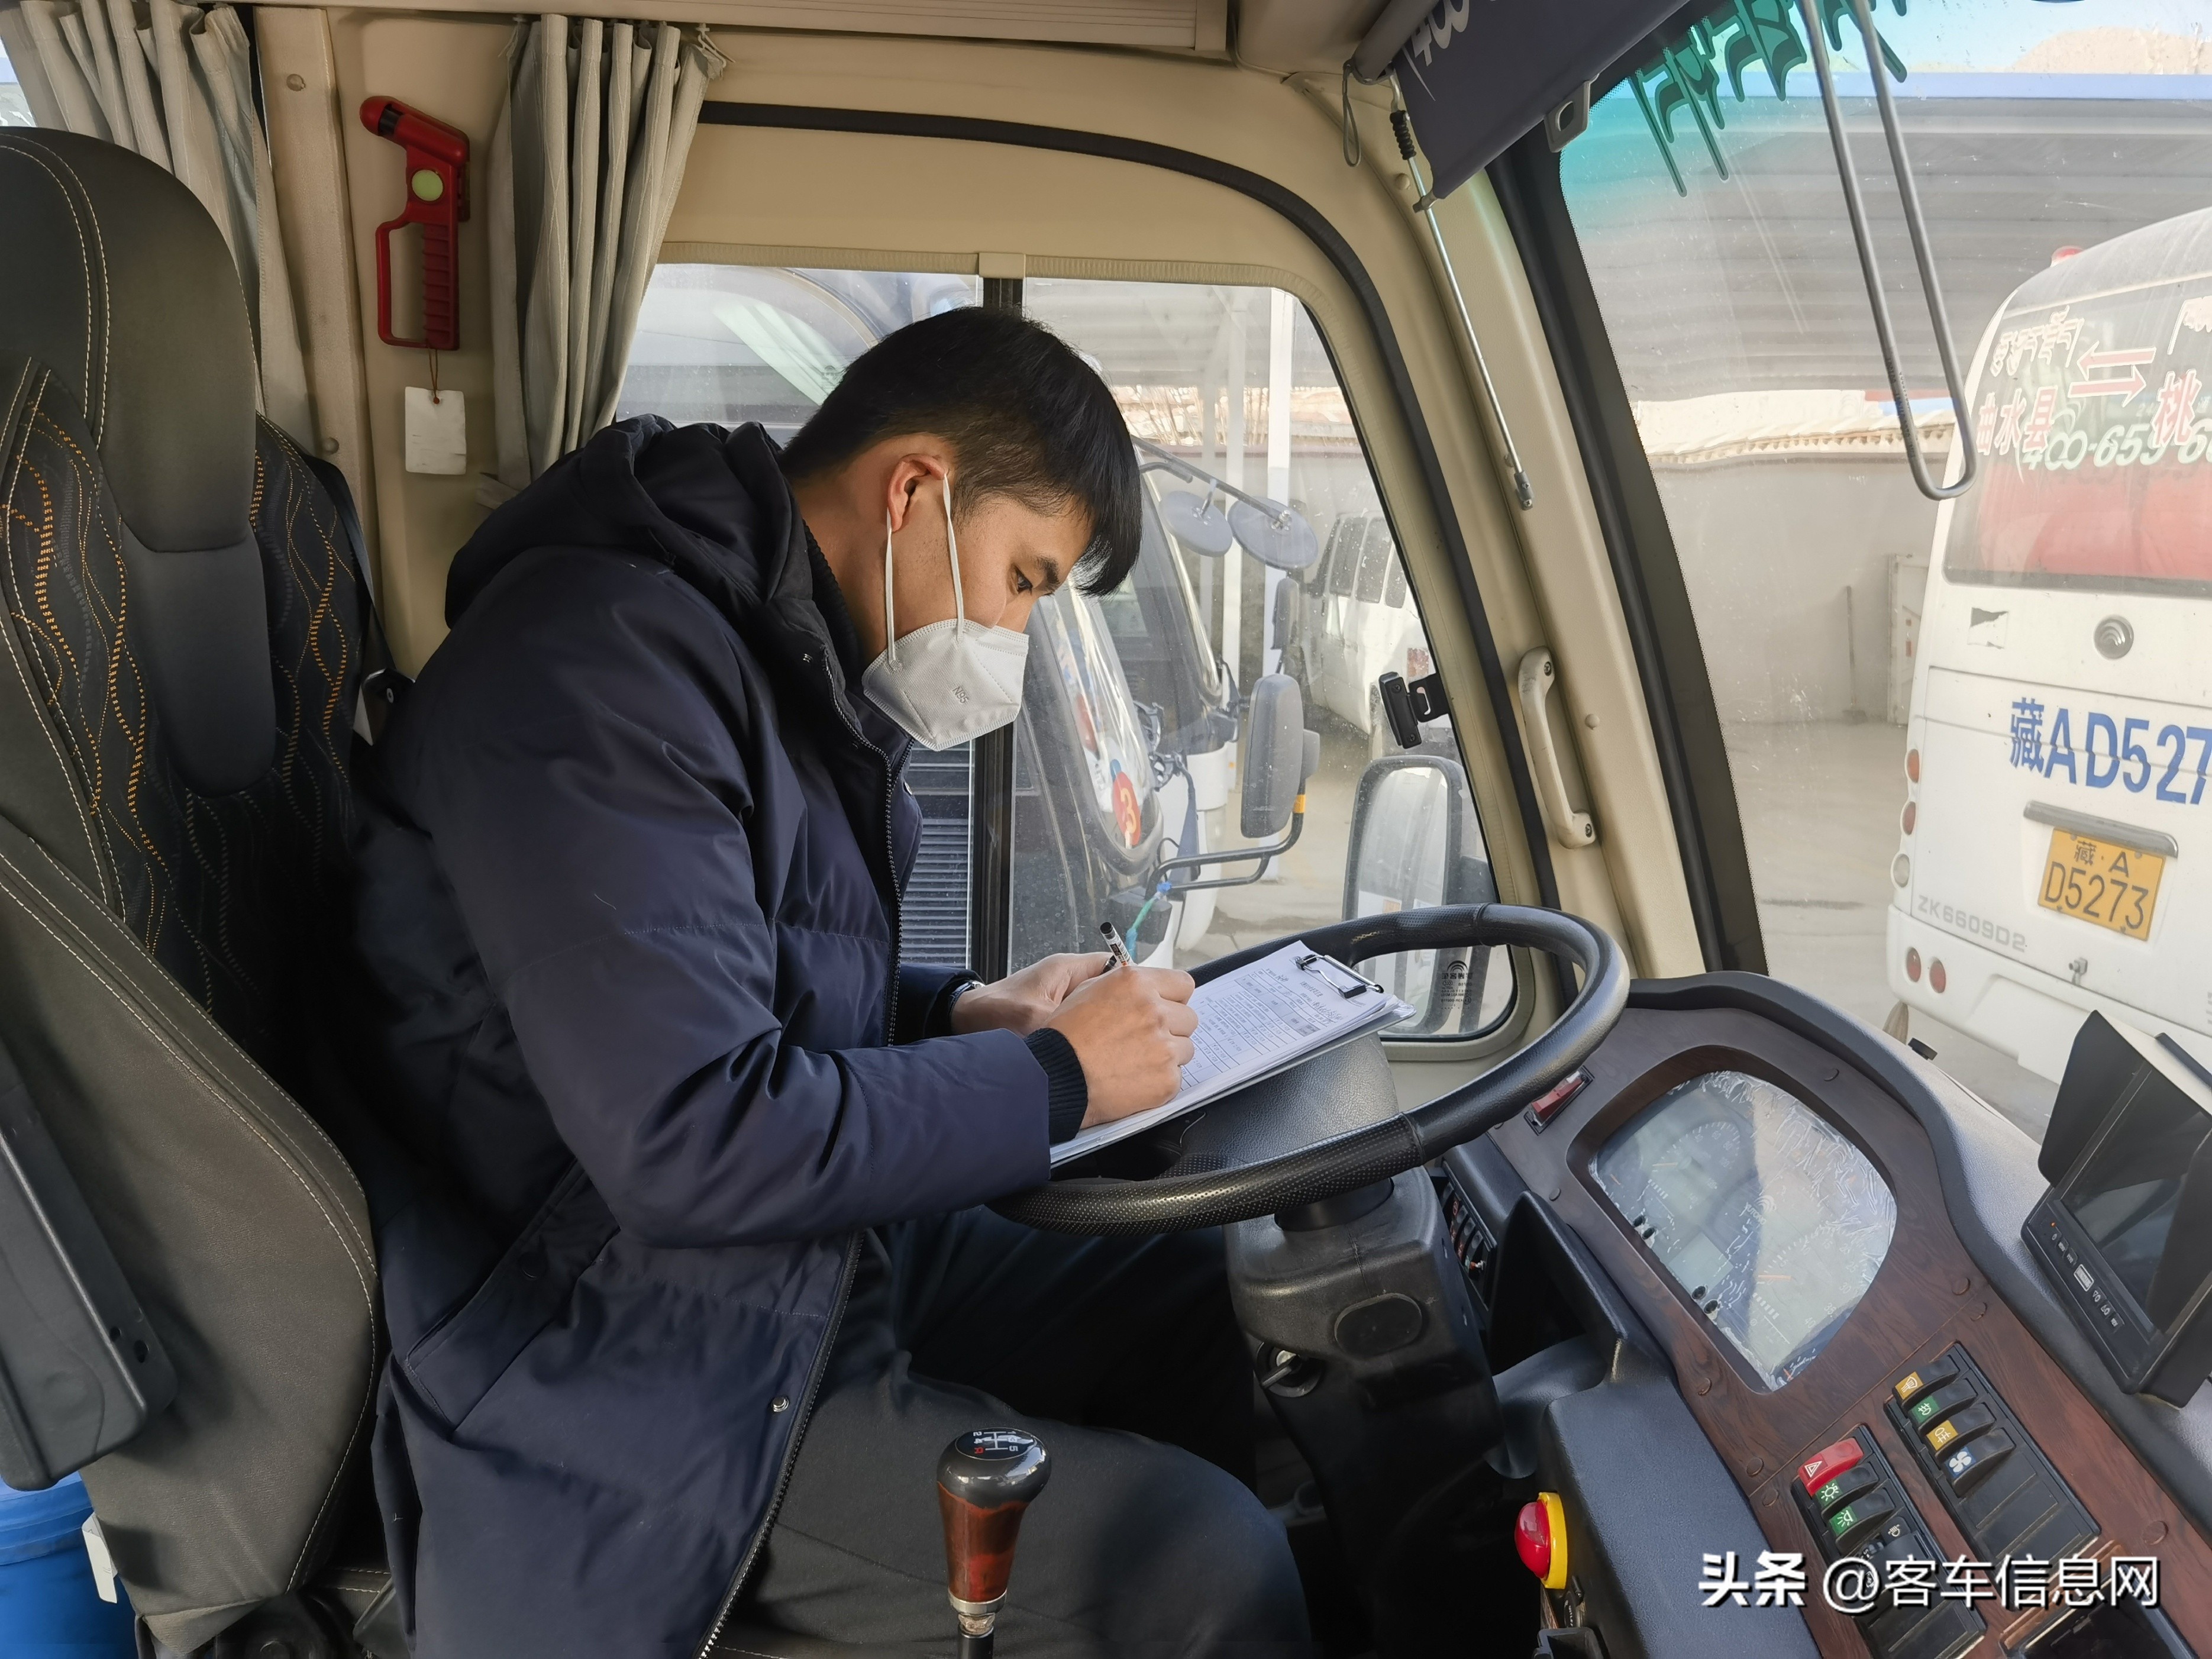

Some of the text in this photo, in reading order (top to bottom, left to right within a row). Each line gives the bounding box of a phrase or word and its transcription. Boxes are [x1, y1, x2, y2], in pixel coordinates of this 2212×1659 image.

[2150, 369, 2203, 448] 桃
[952, 686, 970, 704] N95
[2044, 861, 2149, 929] D5273
